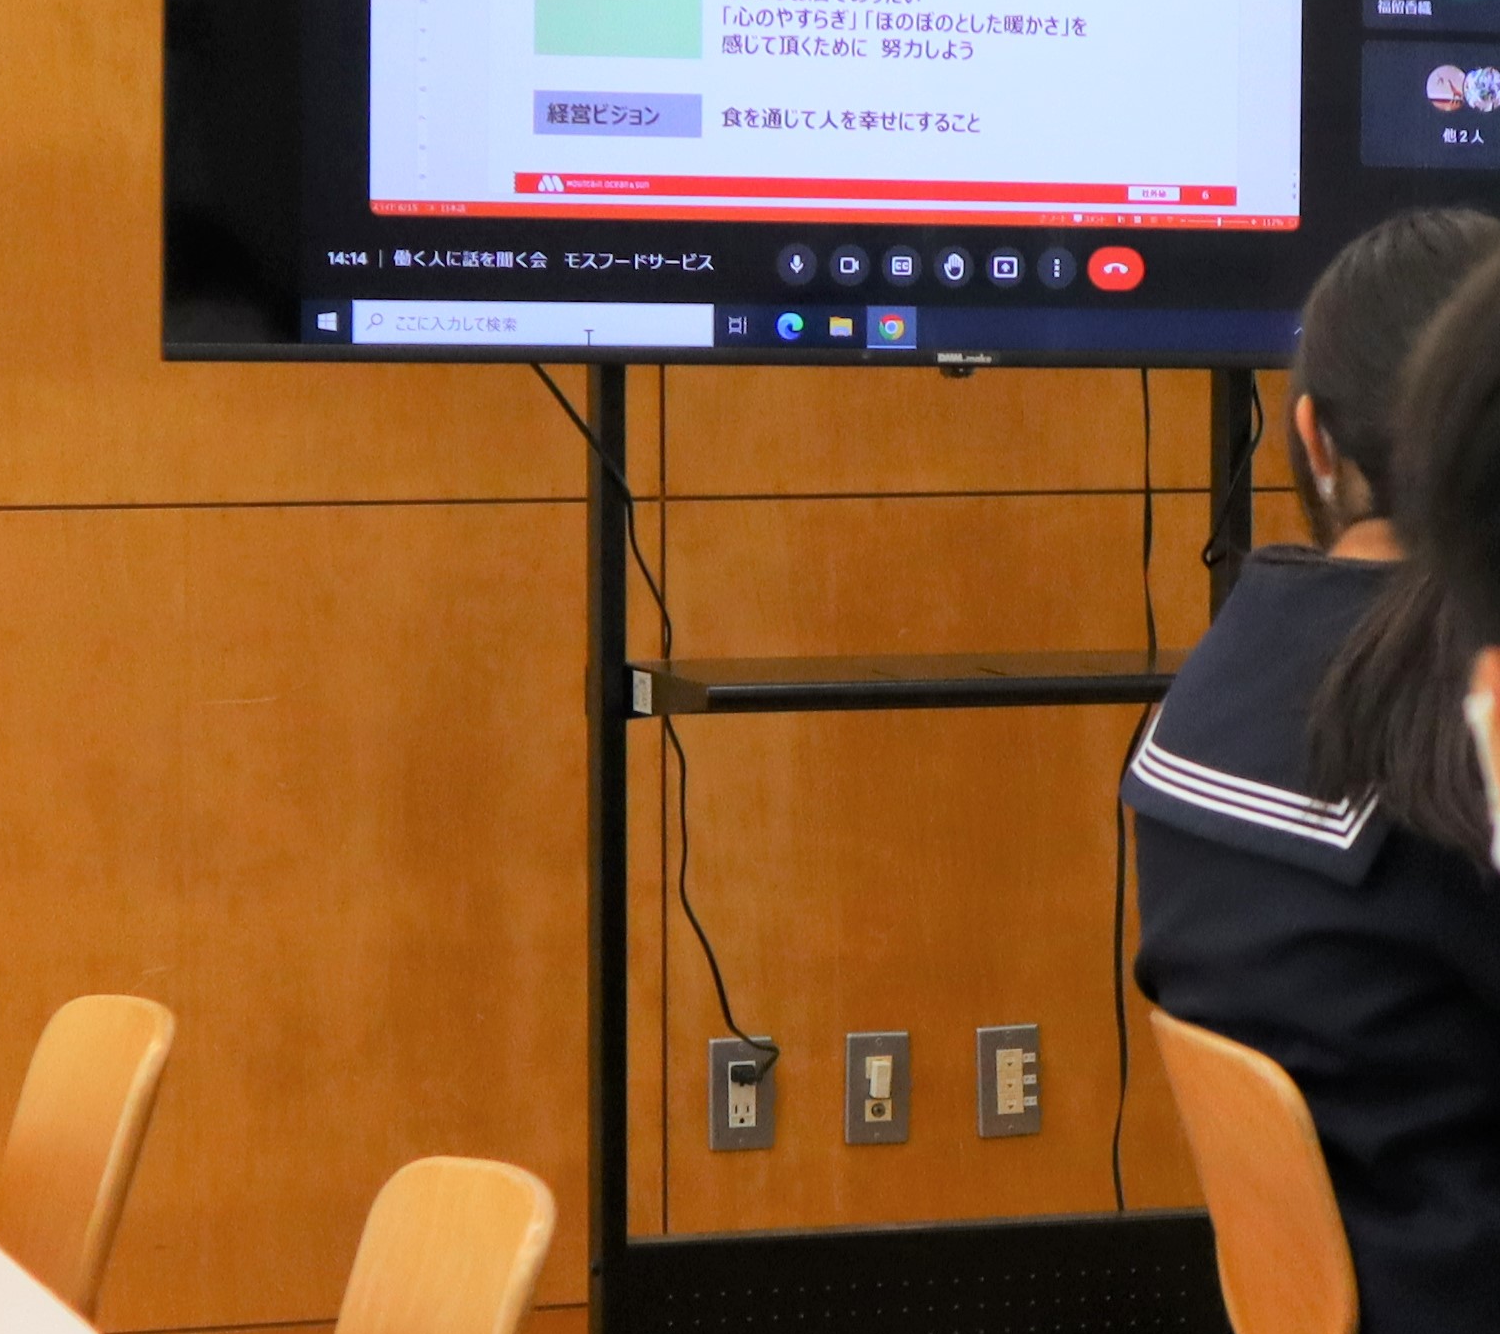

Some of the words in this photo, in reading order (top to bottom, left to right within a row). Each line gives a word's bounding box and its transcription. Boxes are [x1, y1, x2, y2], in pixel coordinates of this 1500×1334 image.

[721, 34, 867, 58] 感じて頂くために
[881, 38, 974, 60] 努力しよう
[547, 102, 661, 127] 経営ビジョン
[722, 106, 981, 133] 食を通じて人を幸せにすること
[1201, 189, 1209, 200] 6
[328, 252, 368, 266] 14:14
[394, 250, 548, 269] 働く人に話を聞く会
[564, 253, 714, 271] モスフードサービス
[396, 316, 517, 333] ここに入力して検索
